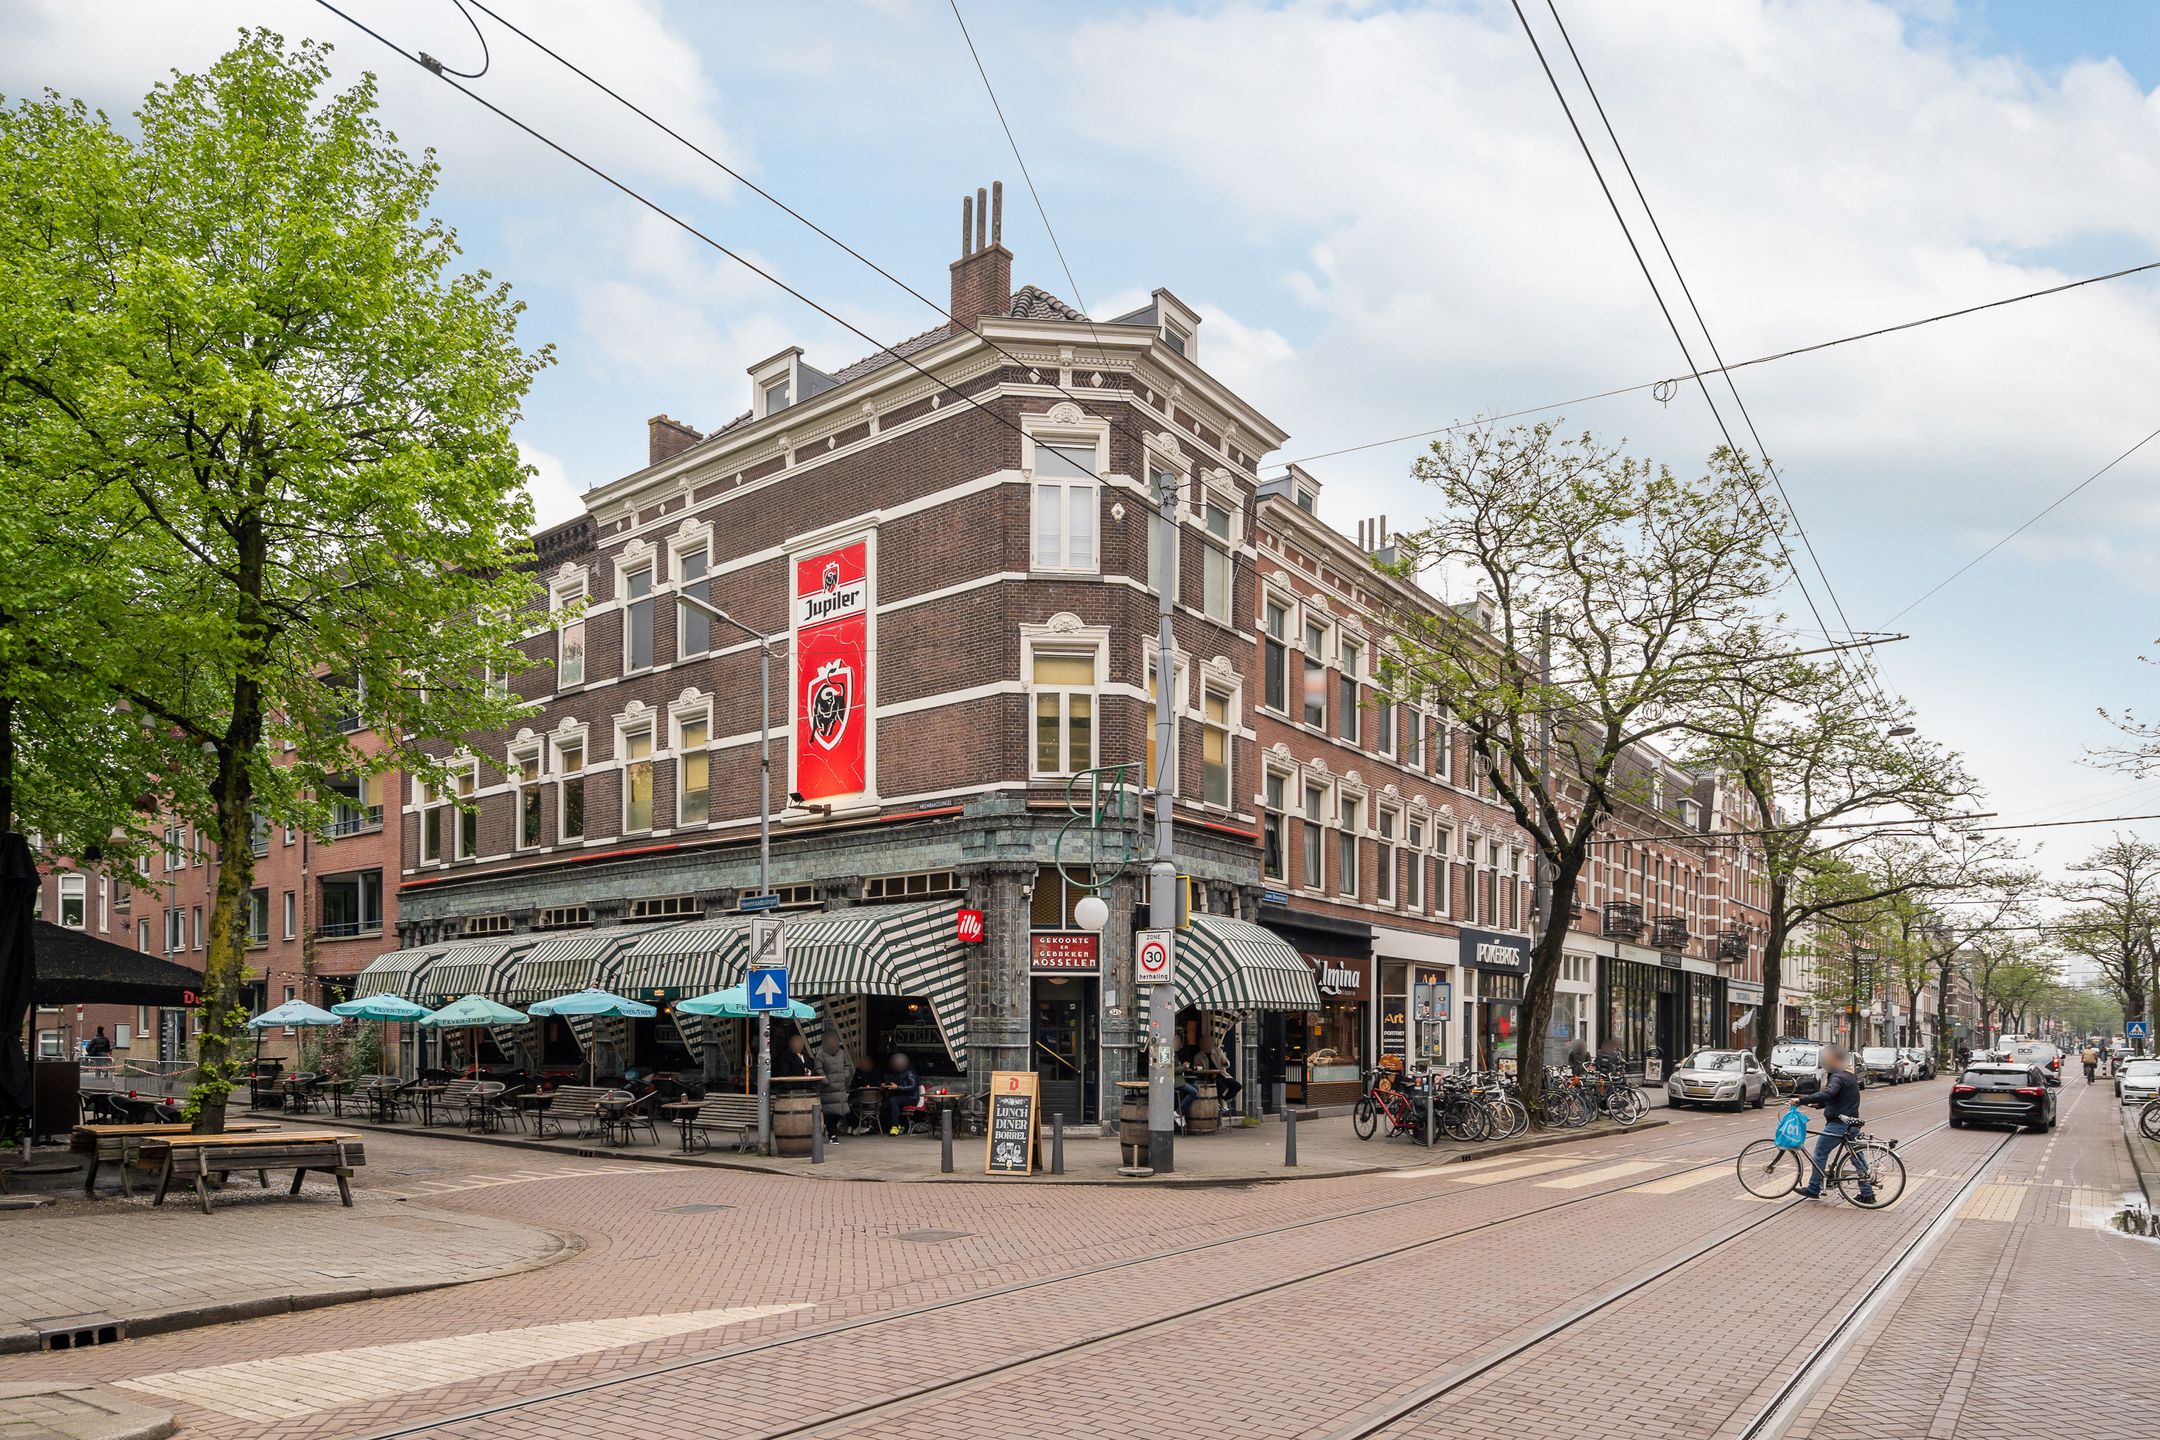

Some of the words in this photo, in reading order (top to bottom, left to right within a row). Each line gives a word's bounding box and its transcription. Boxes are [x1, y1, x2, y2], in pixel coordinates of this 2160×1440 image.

[804, 590, 860, 621] Jupiler
[960, 914, 982, 939] illy
[1146, 951, 1162, 963] 30
[1032, 959, 1096, 967] MOSSELEN
[442, 1017, 486, 1025] FEVER-TREE
[1384, 1013, 1404, 1024] Art
[996, 1107, 1028, 1118] LUNCH
[995, 1119, 1028, 1130] DINER
[994, 1130, 1027, 1140] BORREL
